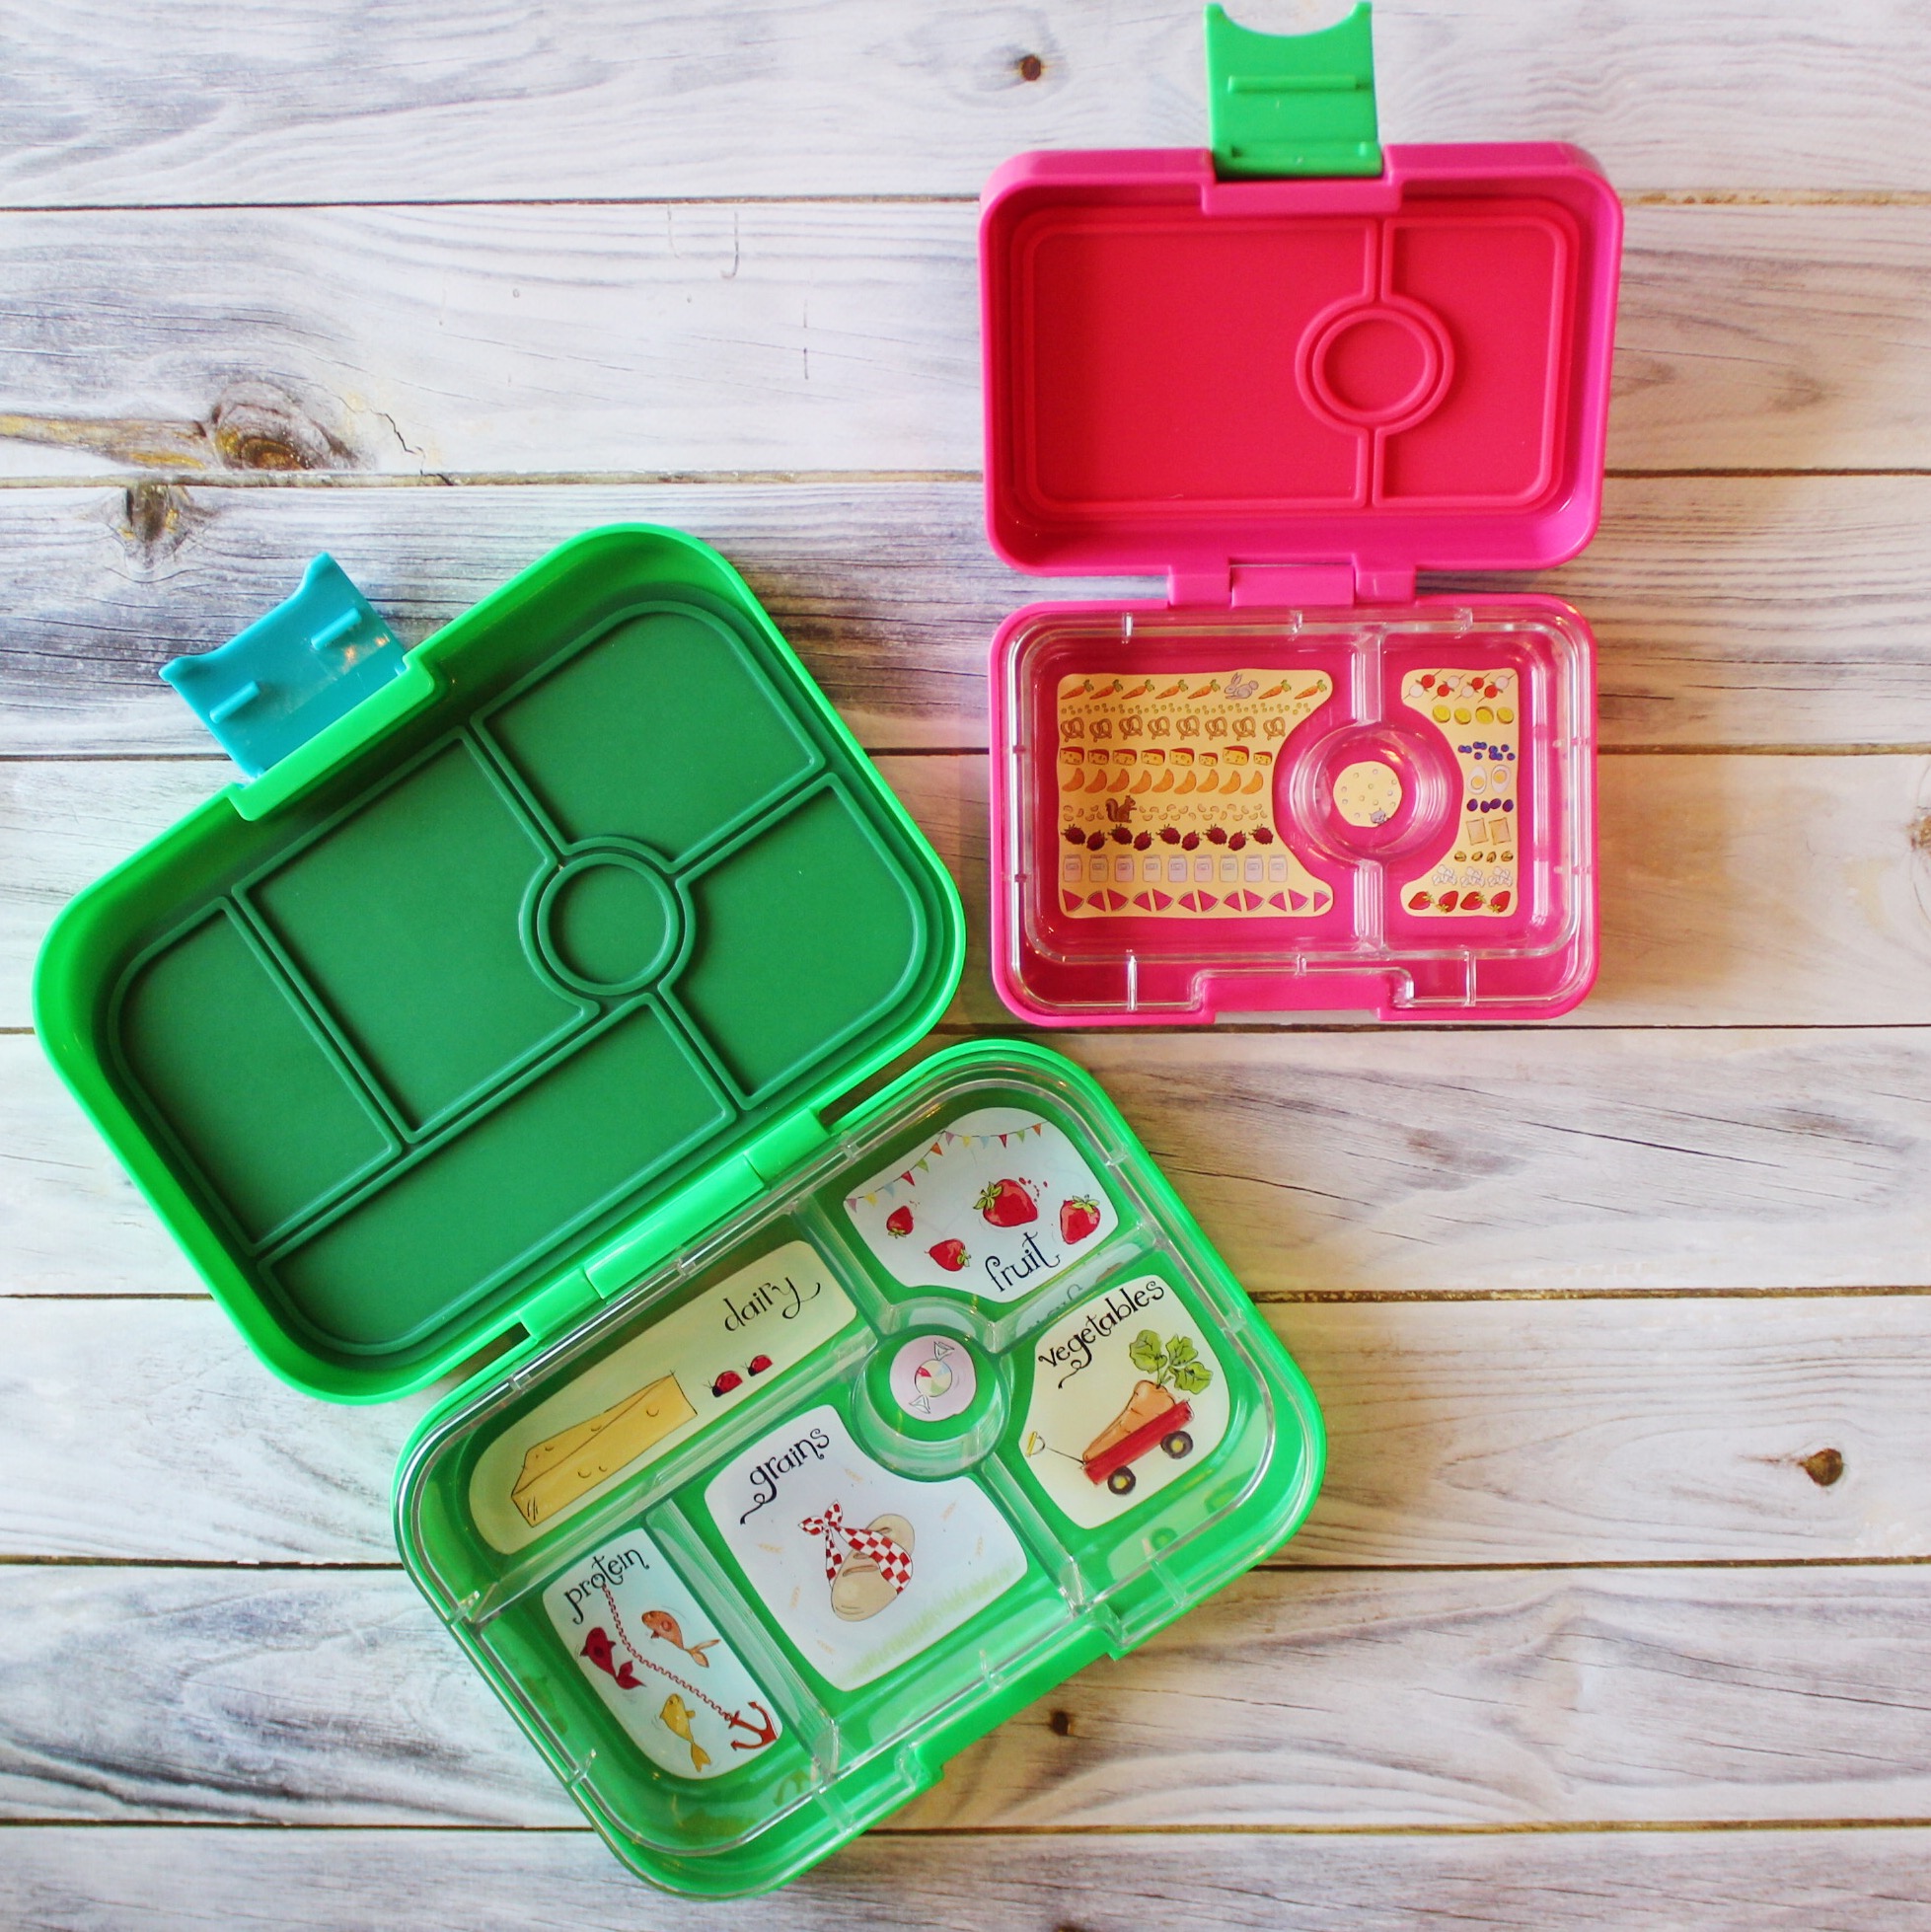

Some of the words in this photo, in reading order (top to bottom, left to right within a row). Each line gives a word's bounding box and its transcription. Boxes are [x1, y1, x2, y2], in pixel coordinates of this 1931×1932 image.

[985, 1231, 1061, 1292] fruit
[723, 1277, 820, 1331] dairy
[1038, 1281, 1164, 1388] vegetables
[740, 1428, 830, 1524] grains
[563, 1549, 649, 1625] protein
